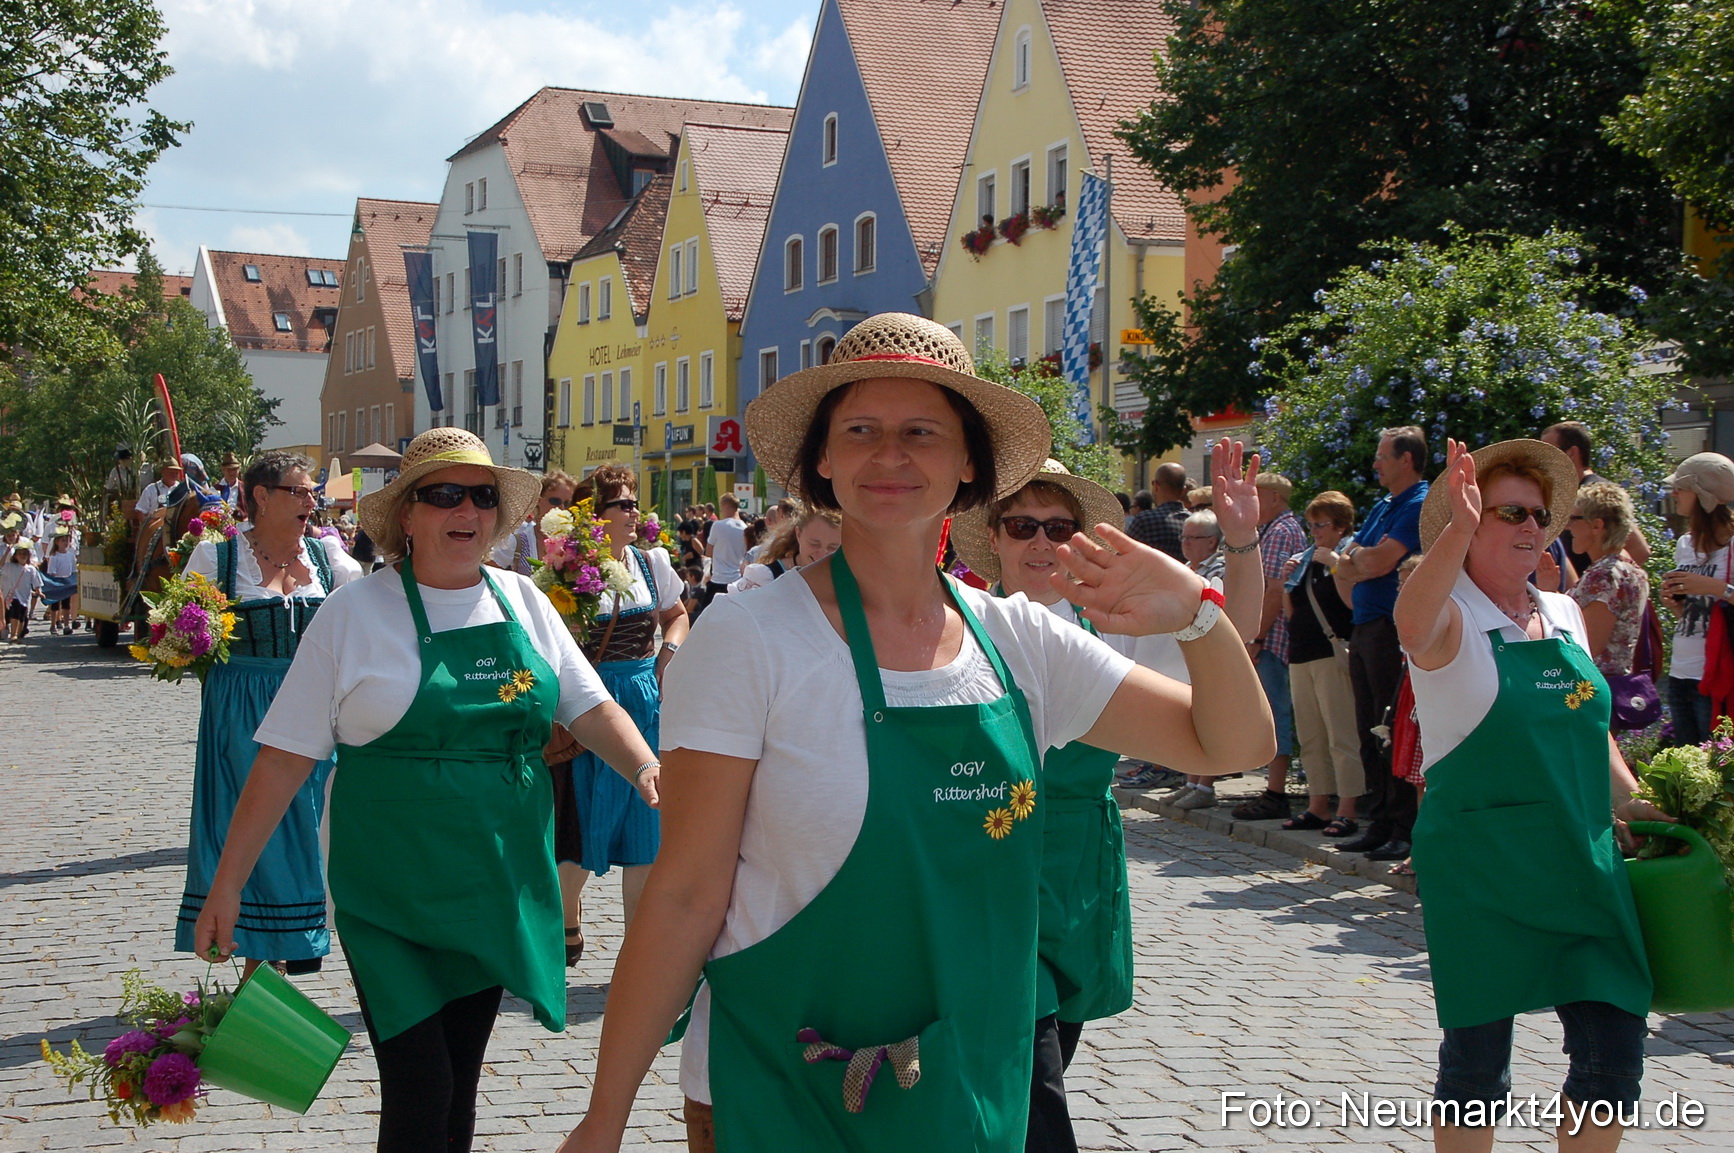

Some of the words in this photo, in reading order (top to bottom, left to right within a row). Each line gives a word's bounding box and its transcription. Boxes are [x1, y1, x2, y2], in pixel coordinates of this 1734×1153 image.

[589, 345, 611, 367] HOTEL
[671, 427, 689, 441] AIFUN
[586, 446, 617, 462] Restaurant
[475, 657, 497, 668] OGV
[464, 668, 511, 680] Rittershof
[1542, 668, 1562, 677] OGV
[1535, 680, 1575, 690] Rittershof
[950, 761, 985, 777] OGV
[933, 781, 1007, 803] Rittershof
